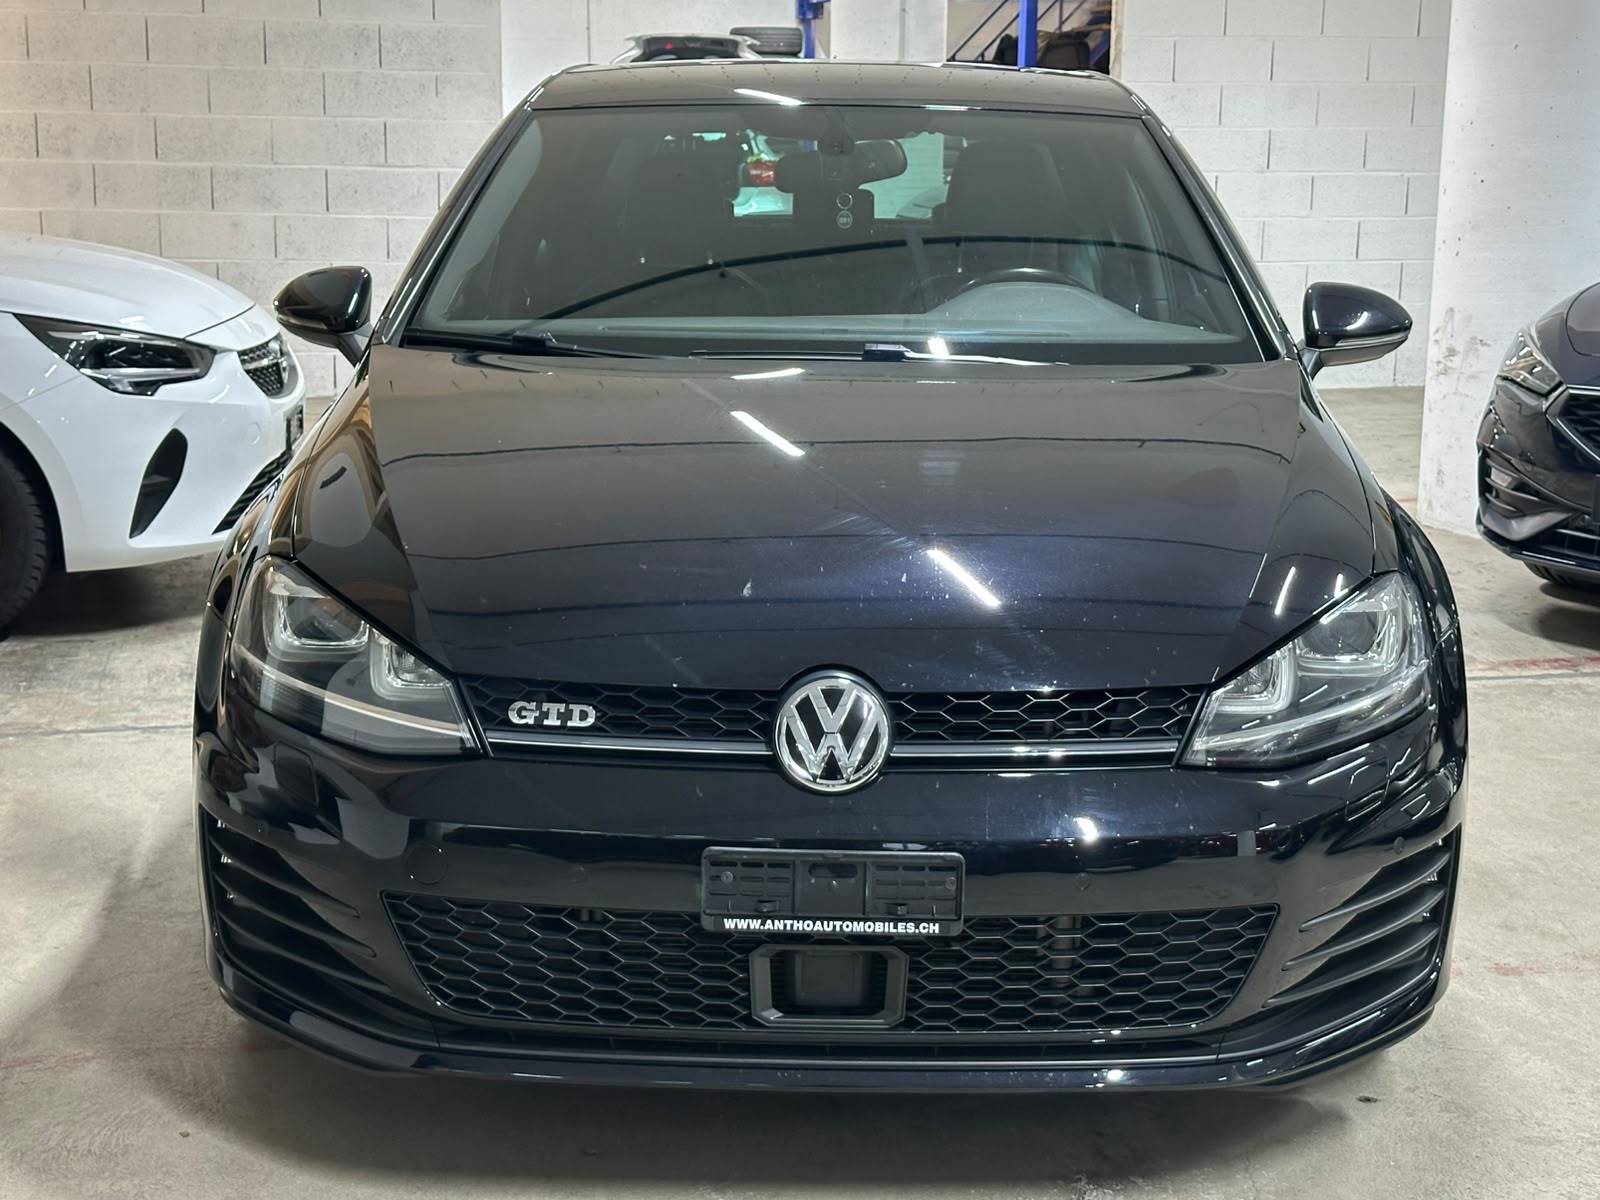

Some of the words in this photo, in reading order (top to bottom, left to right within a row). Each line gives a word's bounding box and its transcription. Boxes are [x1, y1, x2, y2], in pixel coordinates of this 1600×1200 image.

[507, 700, 597, 728] GTD
[778, 675, 889, 790] VW
[722, 917, 940, 934] WWW.ANTHOAUTOMOBILES.CH
